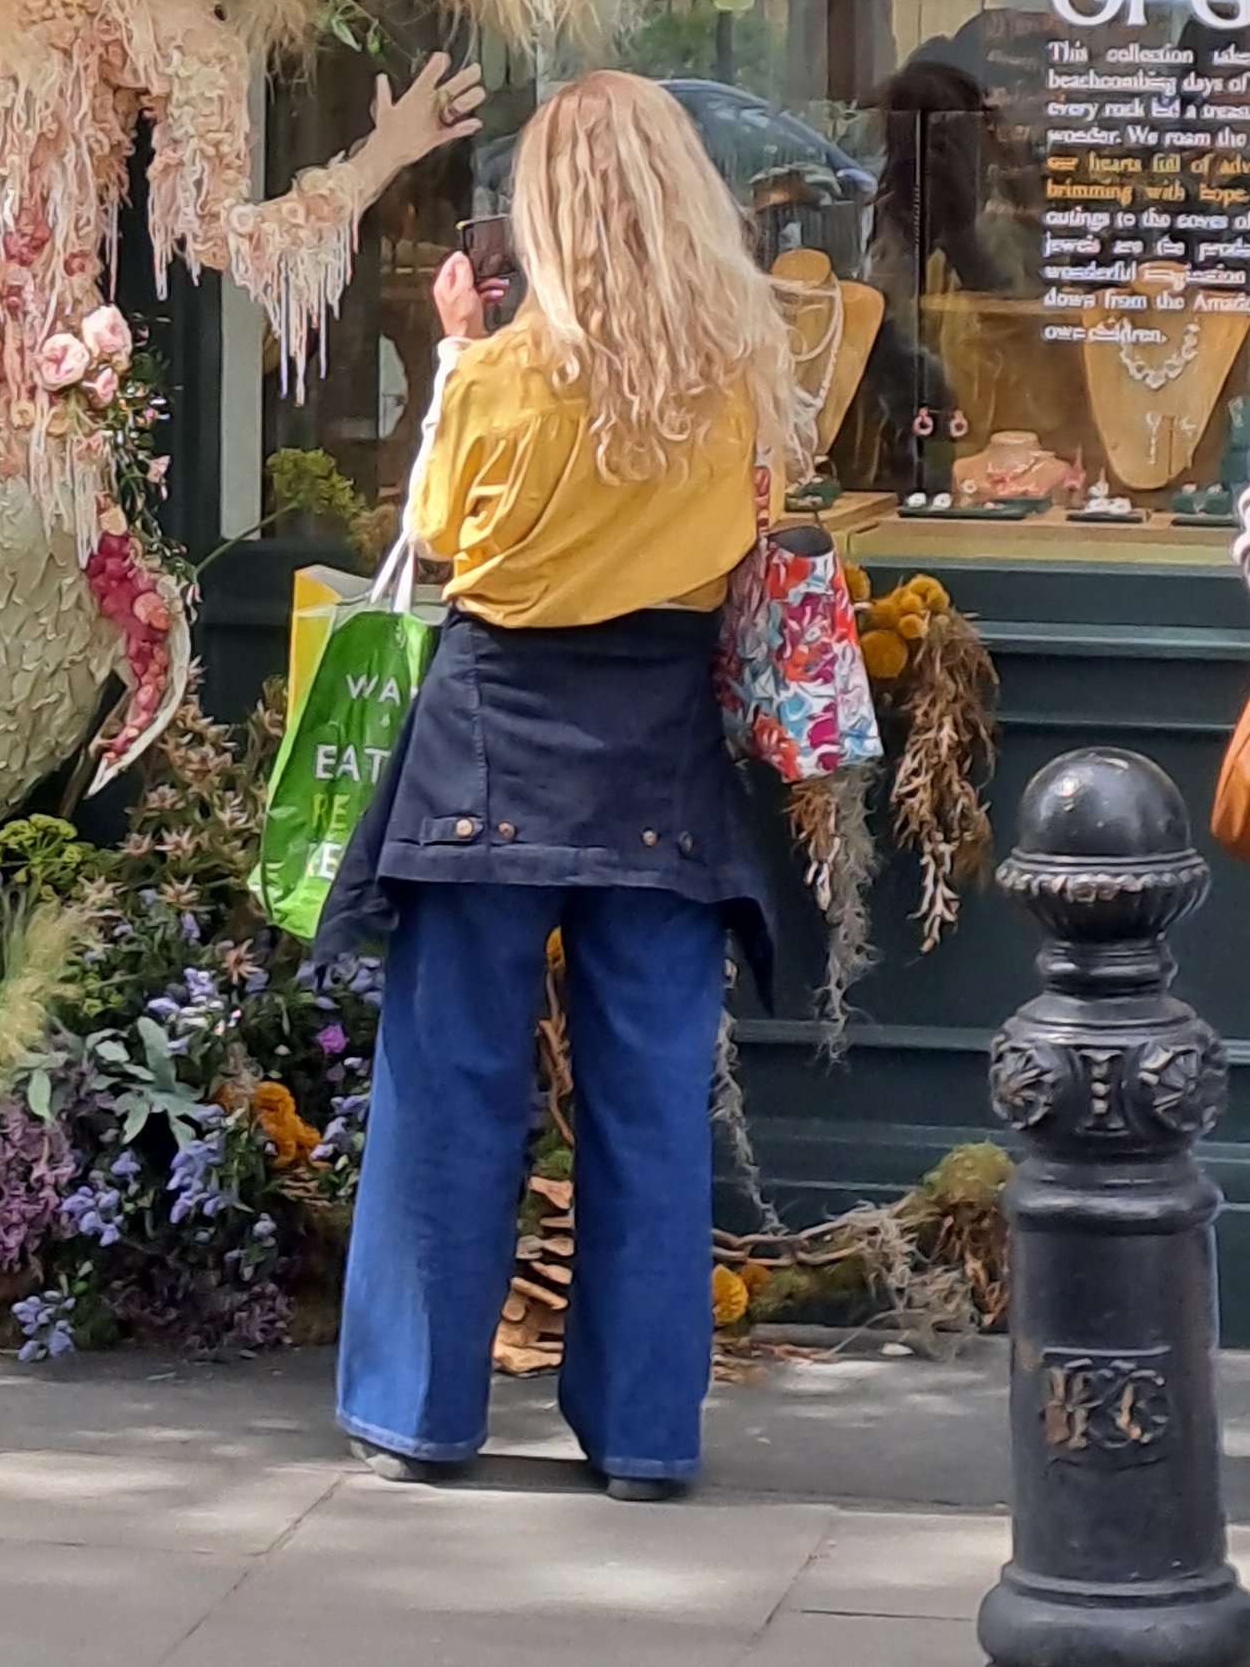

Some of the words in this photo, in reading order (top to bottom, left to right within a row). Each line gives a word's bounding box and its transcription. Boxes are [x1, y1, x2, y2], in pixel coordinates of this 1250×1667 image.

[1047, 39, 1088, 64] This
[1105, 42, 1194, 64] collection
[1047, 68, 1178, 97] beachcombing
[1181, 70, 1223, 98] days
[1046, 101, 1100, 122] every
[1102, 97, 1146, 118] rock
[1182, 104, 1197, 119] a
[1125, 124, 1160, 146] We
[1163, 131, 1212, 148] roam
[1215, 126, 1248, 149] the
[1087, 150, 1143, 174] hearts
[1151, 152, 1182, 174] full
[1189, 152, 1215, 176] of
[1046, 177, 1134, 207] brimming
[1143, 179, 1187, 202] with
[1044, 205, 1111, 232] outings
[1115, 211, 1136, 229] to
[1140, 206, 1171, 229] the
[1112, 238, 1144, 255] are
[1042, 259, 1137, 282] wonderful
[1043, 286, 1097, 309] down
[1103, 287, 1148, 311] from
[1154, 289, 1185, 311] the
[315, 743, 393, 784] EAT
